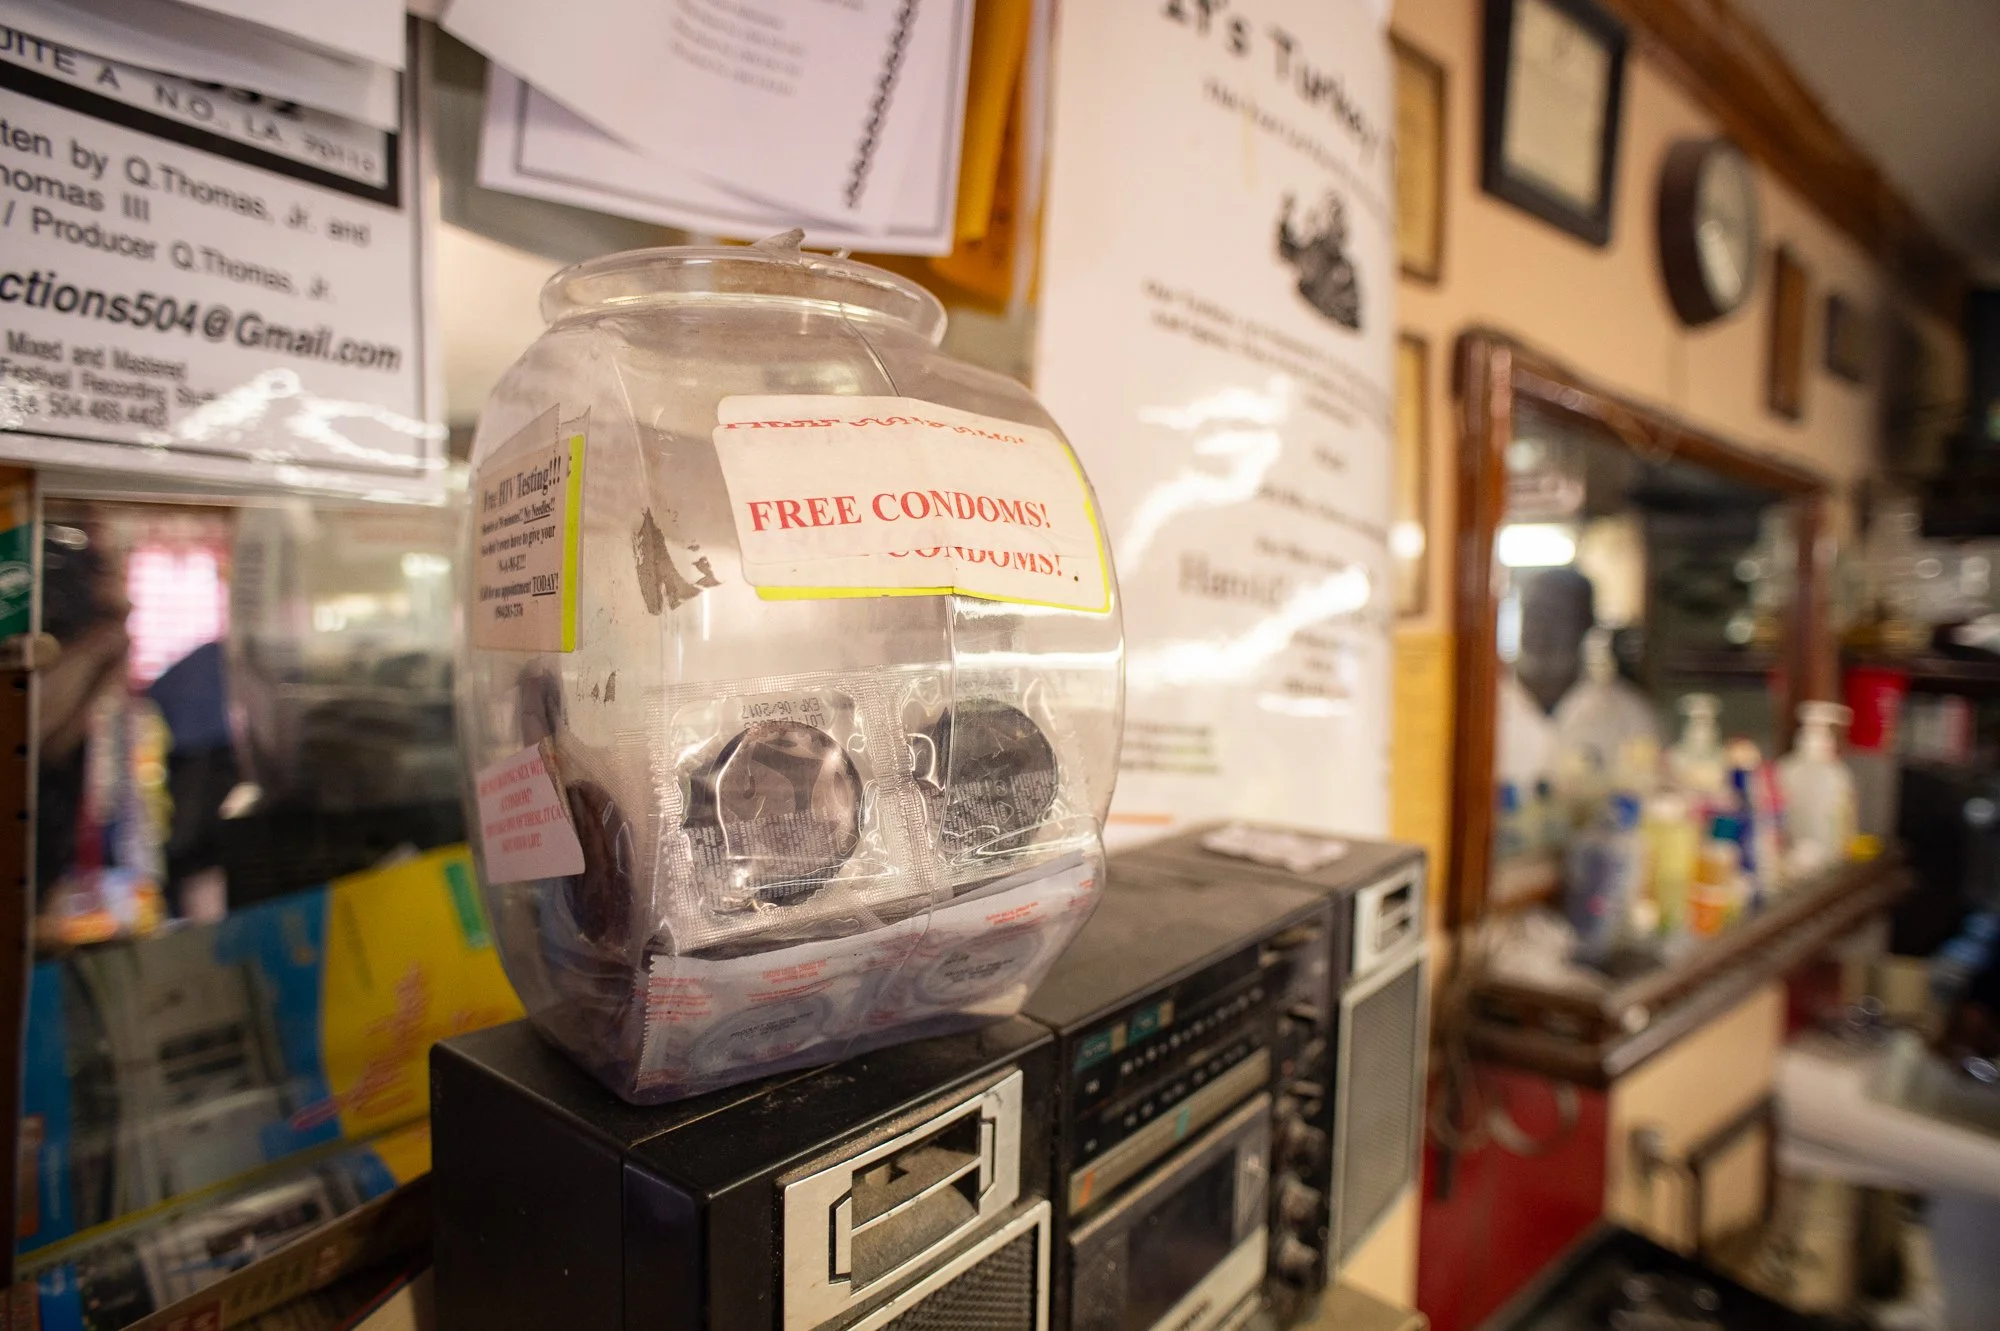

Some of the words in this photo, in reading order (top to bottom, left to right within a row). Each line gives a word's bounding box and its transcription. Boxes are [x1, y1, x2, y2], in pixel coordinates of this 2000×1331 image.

[97, 64, 120, 90] A
[71, 137, 109, 181] by
[325, 215, 371, 248] and
[121, 192, 150, 223] III
[32, 205, 157, 261] Producer
[0, 270, 402, 372] ctions504@Gmail.com
[499, 477, 513, 507] HIV
[517, 456, 561, 496] Testing!!!
[745, 495, 862, 531] FREE
[872, 489, 1051, 530] CONDOMS!
[523, 532, 528, 545] to
[528, 527, 541, 547] give
[541, 525, 555, 545] your
[532, 572, 558, 592] TODAY!
